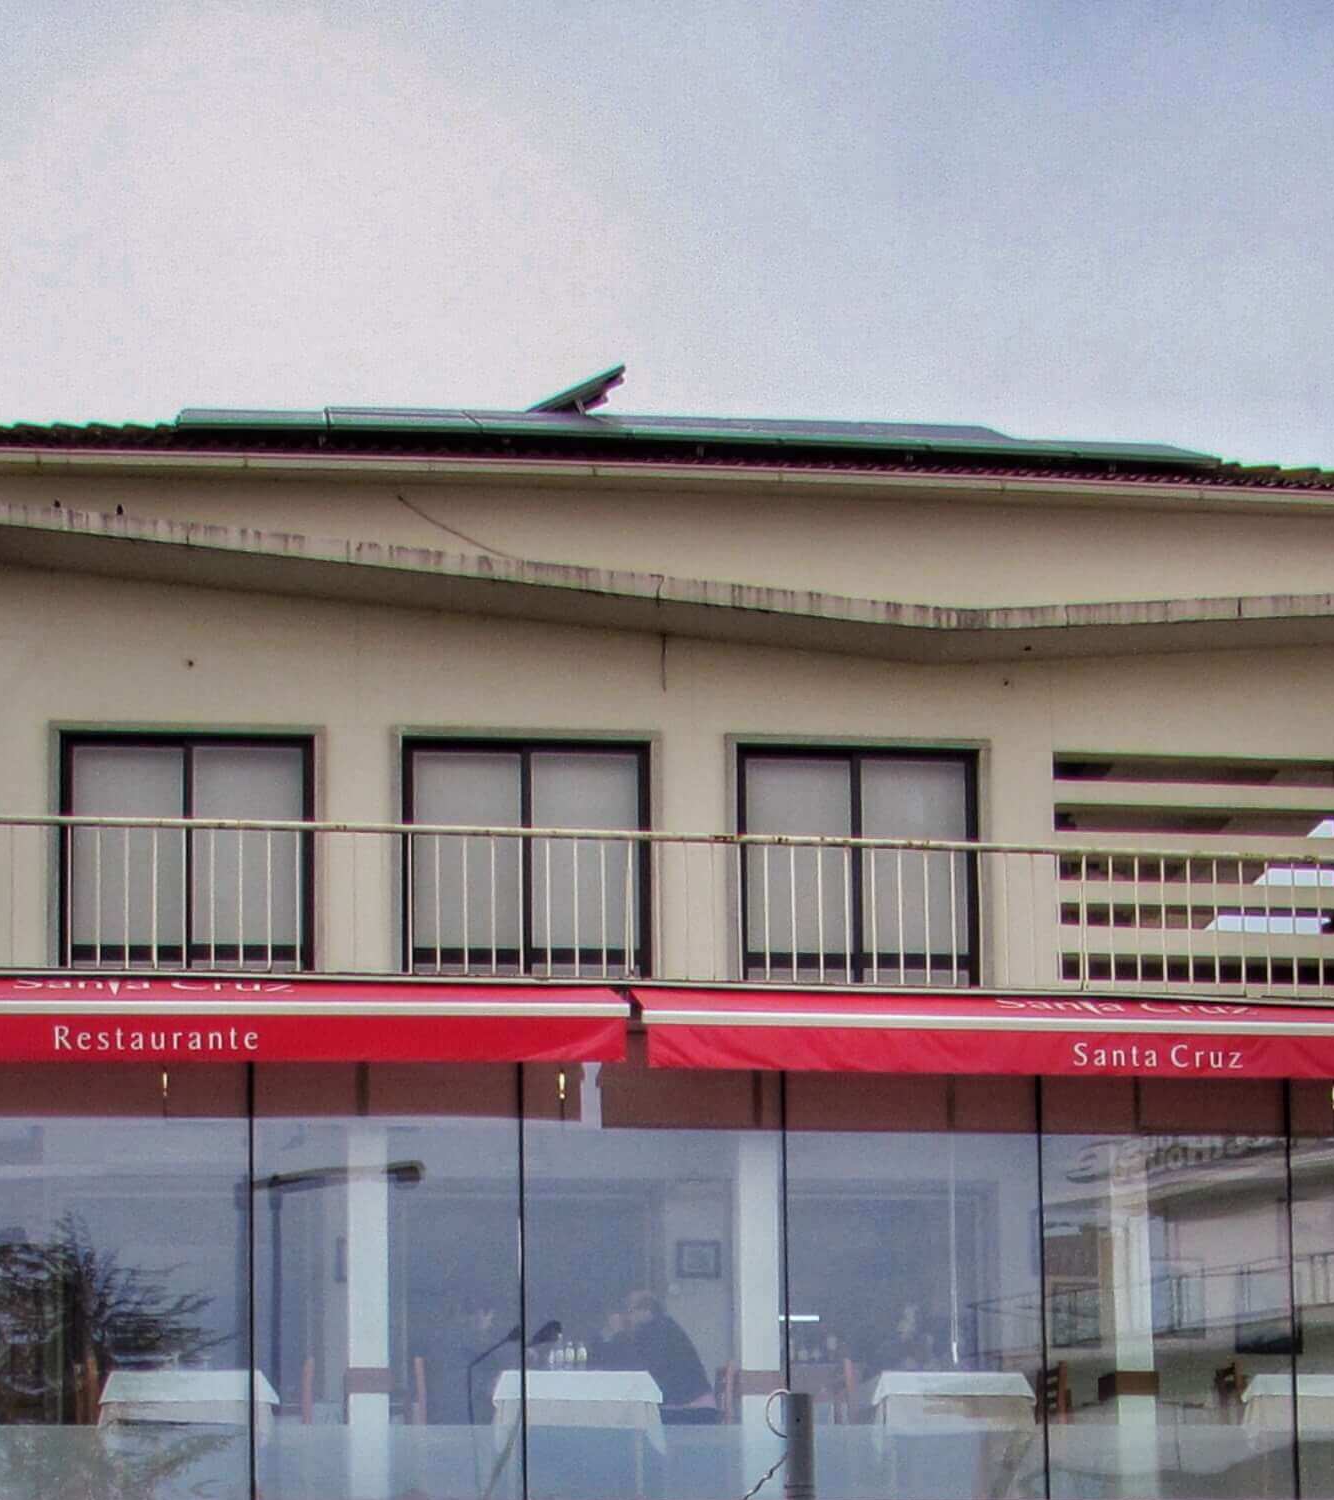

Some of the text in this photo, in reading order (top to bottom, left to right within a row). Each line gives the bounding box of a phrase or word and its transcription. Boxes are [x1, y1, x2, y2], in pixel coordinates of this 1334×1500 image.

[53, 1025, 260, 1050] Restaurante
[1073, 1042, 1244, 1069] Santa Cruz
